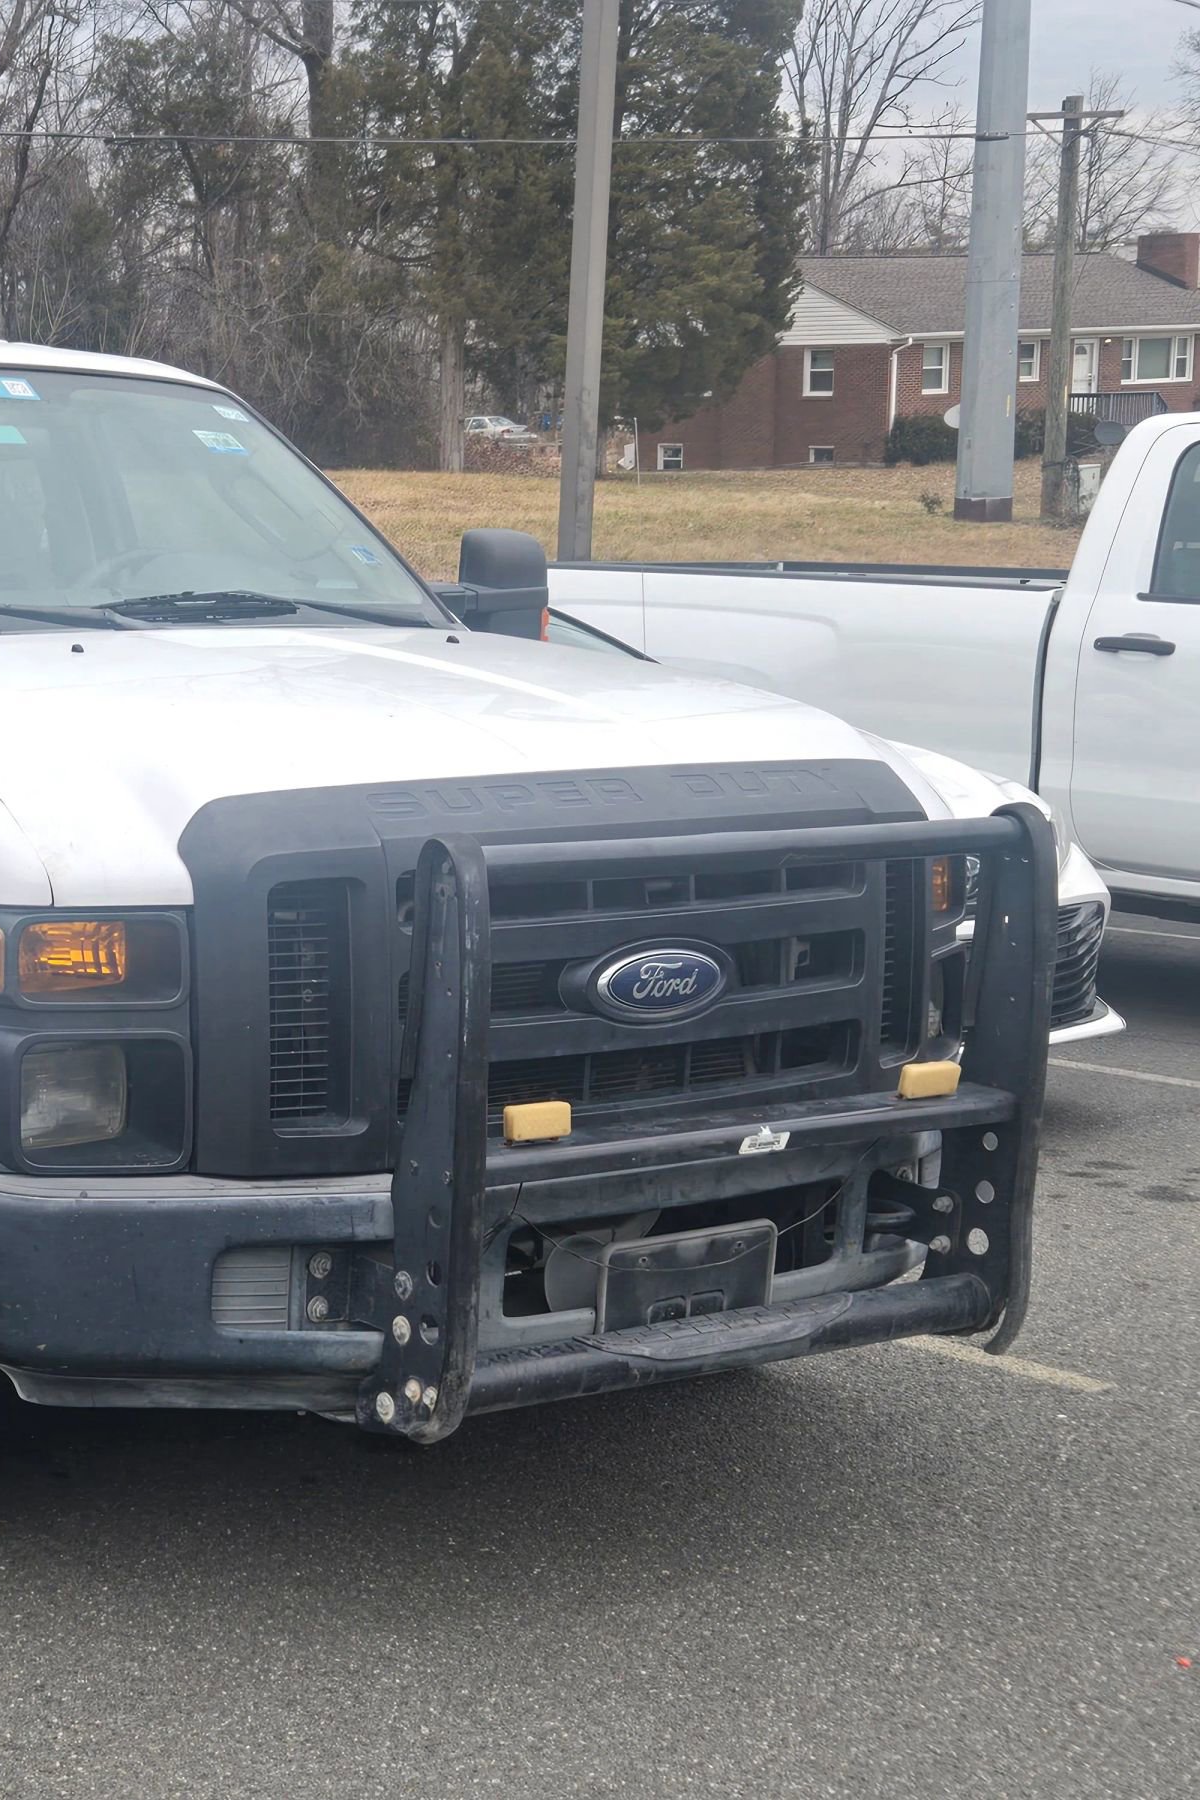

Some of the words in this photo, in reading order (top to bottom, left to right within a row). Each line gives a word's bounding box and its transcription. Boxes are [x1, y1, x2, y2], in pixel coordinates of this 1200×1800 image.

[366, 778, 645, 821] SUPER
[669, 767, 841, 800] DUTY
[632, 962, 699, 999] Ford
